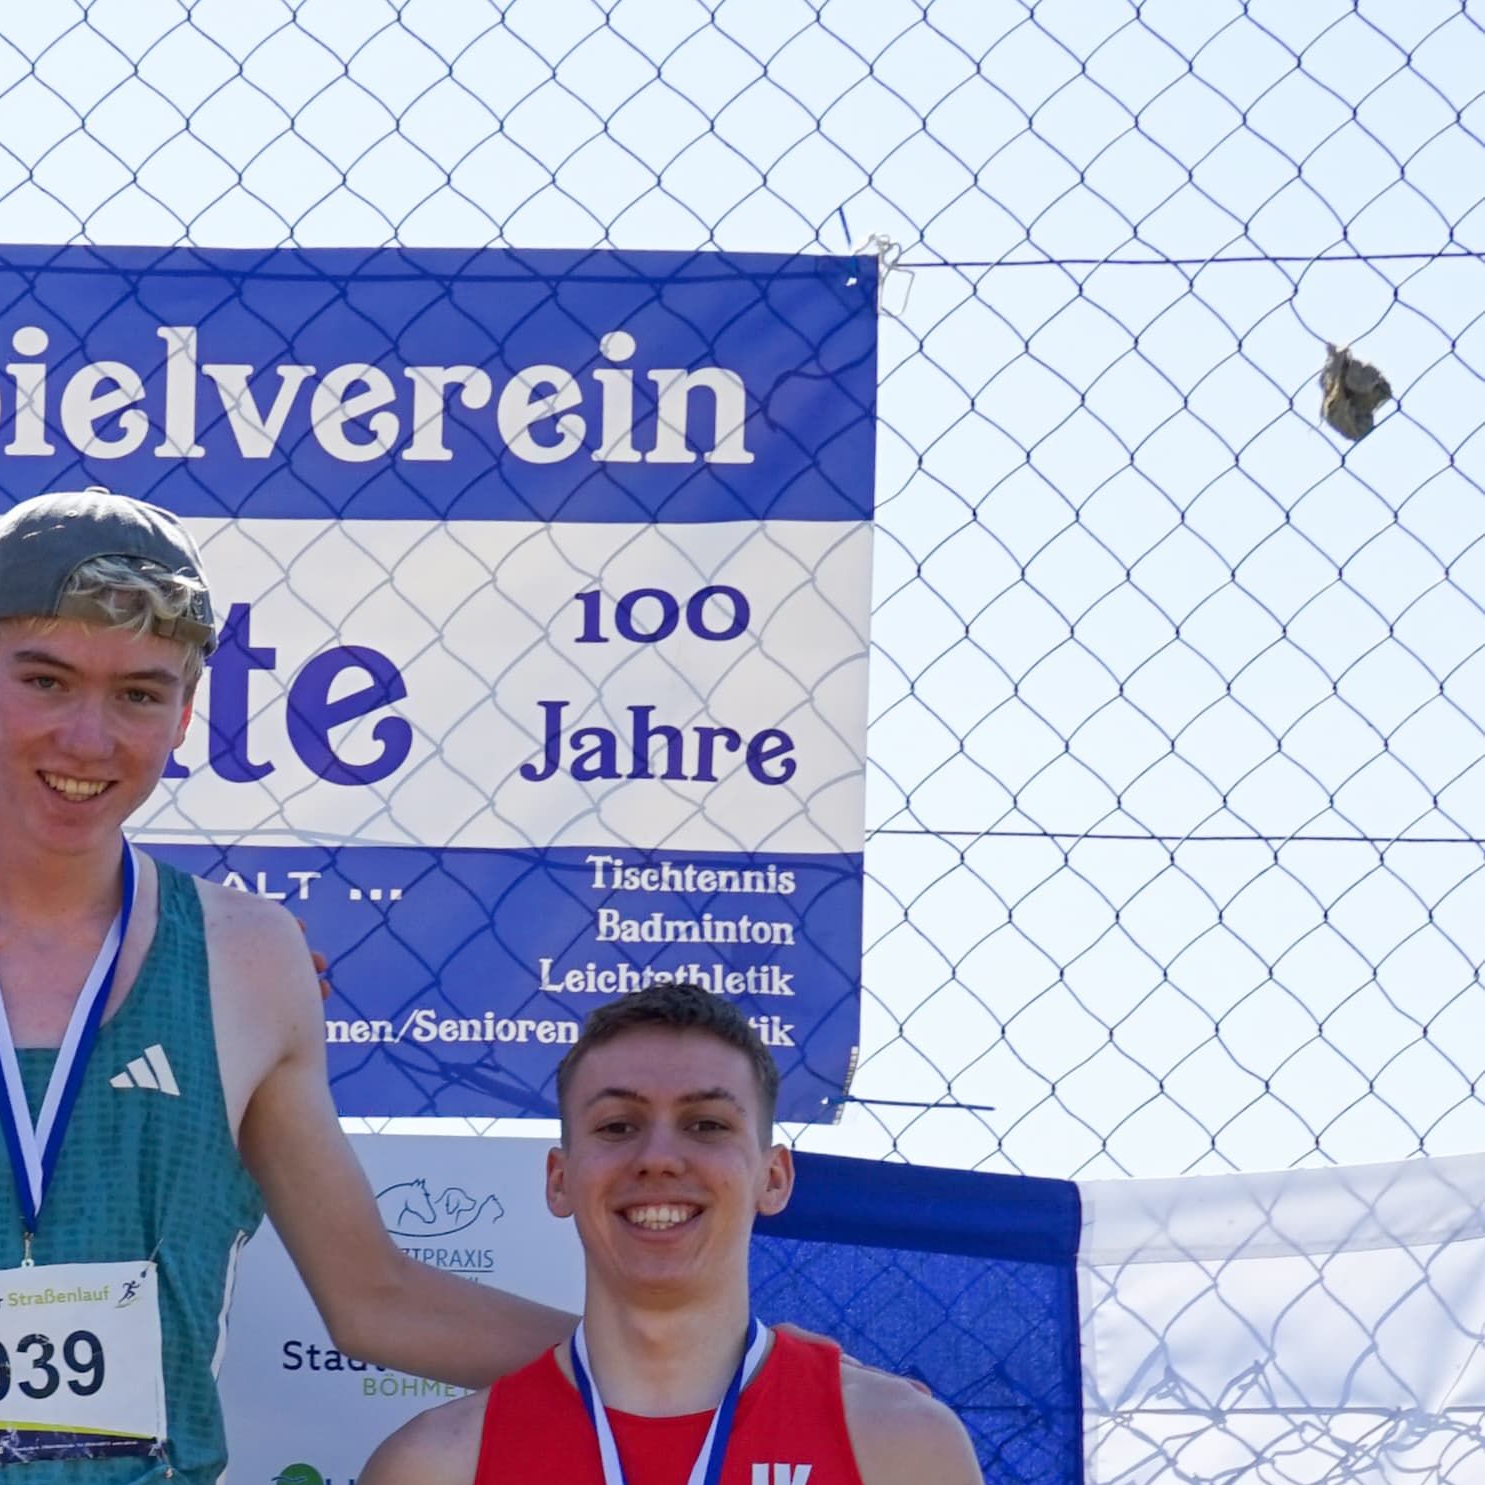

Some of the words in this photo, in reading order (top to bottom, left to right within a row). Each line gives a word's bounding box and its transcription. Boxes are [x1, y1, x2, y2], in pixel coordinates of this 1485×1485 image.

[573, 585, 751, 644] 100
[519, 699, 797, 786] Jahre
[221, 872, 321, 899] ALT
[585, 854, 796, 895] Tischtennis
[595, 908, 795, 945] Badminton
[7, 1286, 110, 1308] Straßenlauf
